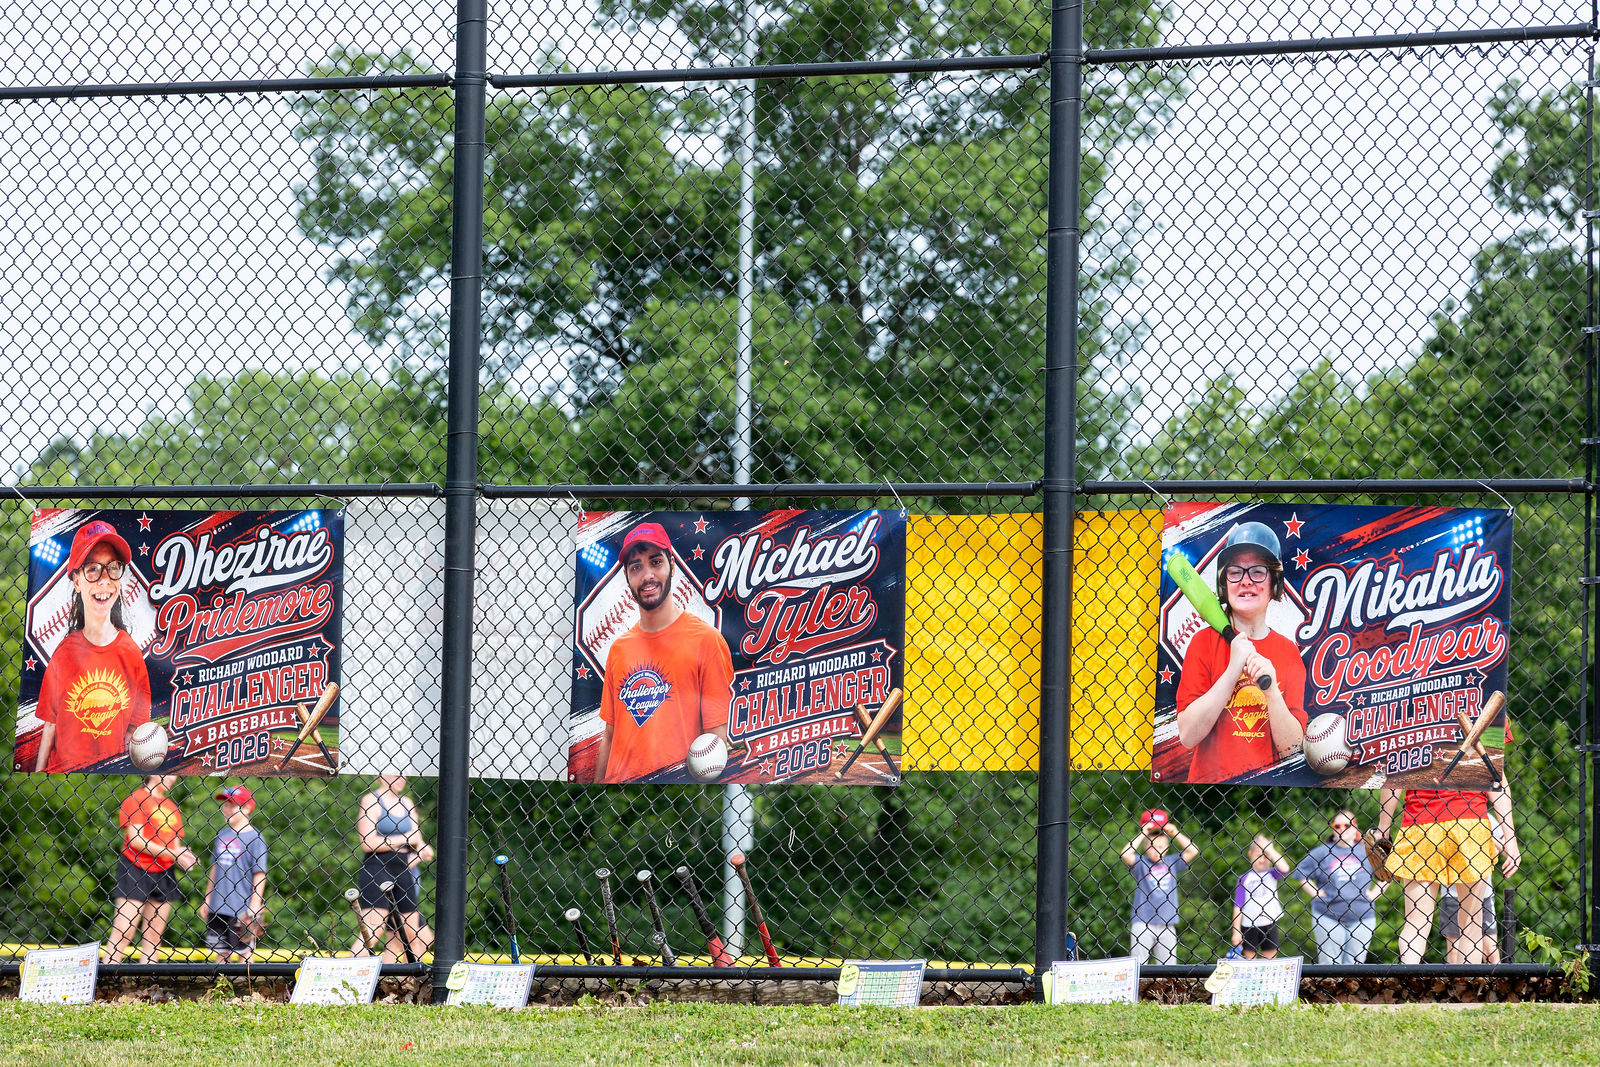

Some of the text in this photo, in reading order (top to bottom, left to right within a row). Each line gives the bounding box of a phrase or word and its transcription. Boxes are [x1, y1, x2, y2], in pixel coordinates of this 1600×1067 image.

[151, 528, 331, 599] Dhezirae
[704, 516, 876, 600] Michael
[1299, 544, 1499, 639] Mikahla
[152, 587, 331, 656] Pridemore
[742, 585, 875, 663] Tyler
[198, 645, 303, 683] RICHARD WOODARD
[756, 651, 866, 689] RICHARD WOODARD
[1312, 617, 1506, 705] Goodyear
[173, 661, 325, 729] CHALLENGER
[619, 682, 672, 700] Challenger
[626, 698, 659, 713] League
[731, 665, 888, 737] CHALLENGER
[1371, 674, 1461, 704] RICHARD WOODARD
[207, 711, 287, 742] BASEBALL
[769, 718, 849, 749] BASEBALL
[1232, 708, 1269, 721] League
[1349, 687, 1481, 742] CHALLENGER
[216, 731, 270, 769] 2026
[1232, 730, 1265, 738] AMBUCS
[1380, 728, 1447, 752] BASEBALL
[775, 738, 832, 777] 2026
[1387, 744, 1432, 774] 2026
